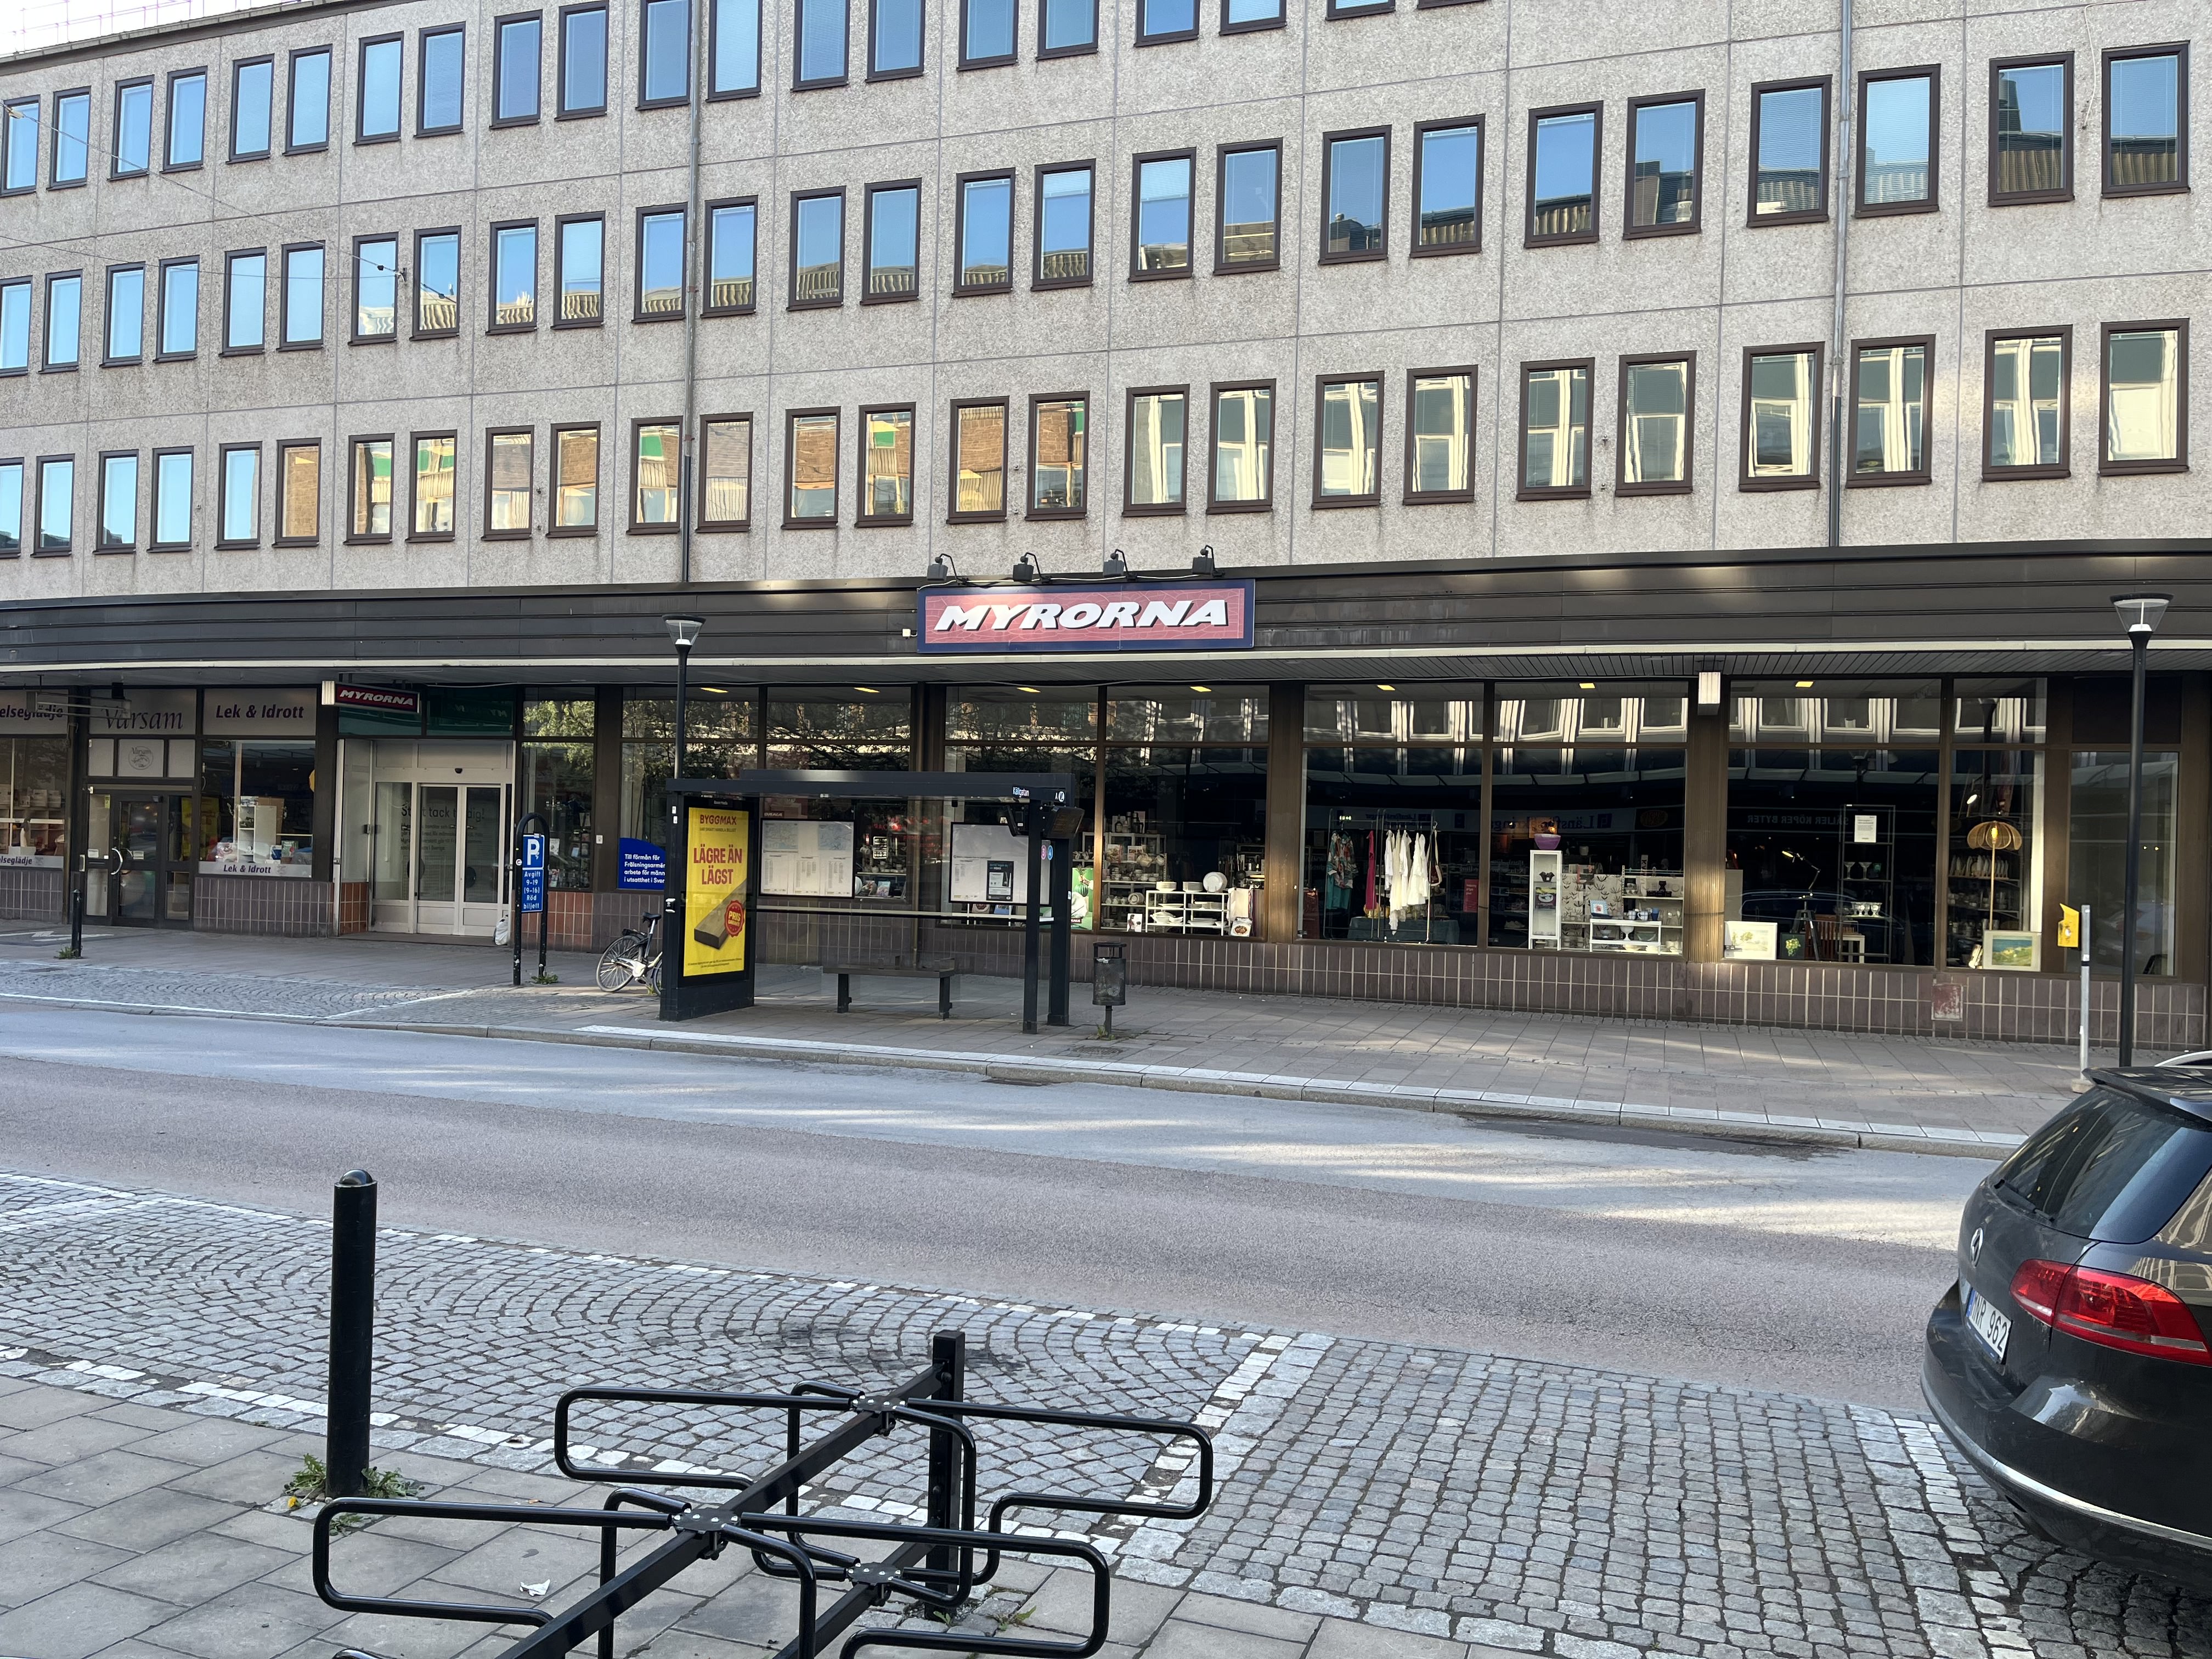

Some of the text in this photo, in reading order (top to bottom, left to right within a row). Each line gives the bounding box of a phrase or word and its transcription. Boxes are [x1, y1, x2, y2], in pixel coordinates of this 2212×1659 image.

[934, 599, 1229, 631] MYRORNA
[340, 690, 413, 706] MYRORNA
[216, 704, 304, 719] Lek & Idrott
[429, 806, 449, 817] tack
[700, 815, 737, 825] BYGGMAX
[527, 839, 540, 865] P
[693, 844, 742, 864] LÄGRE ÄN
[223, 864, 237, 873] Lek
[248, 865, 272, 873] Idrott
[702, 865, 733, 885] LÄGST
[729, 911, 741, 922] PRIS
[1987, 1310, 2007, 1352] 962
